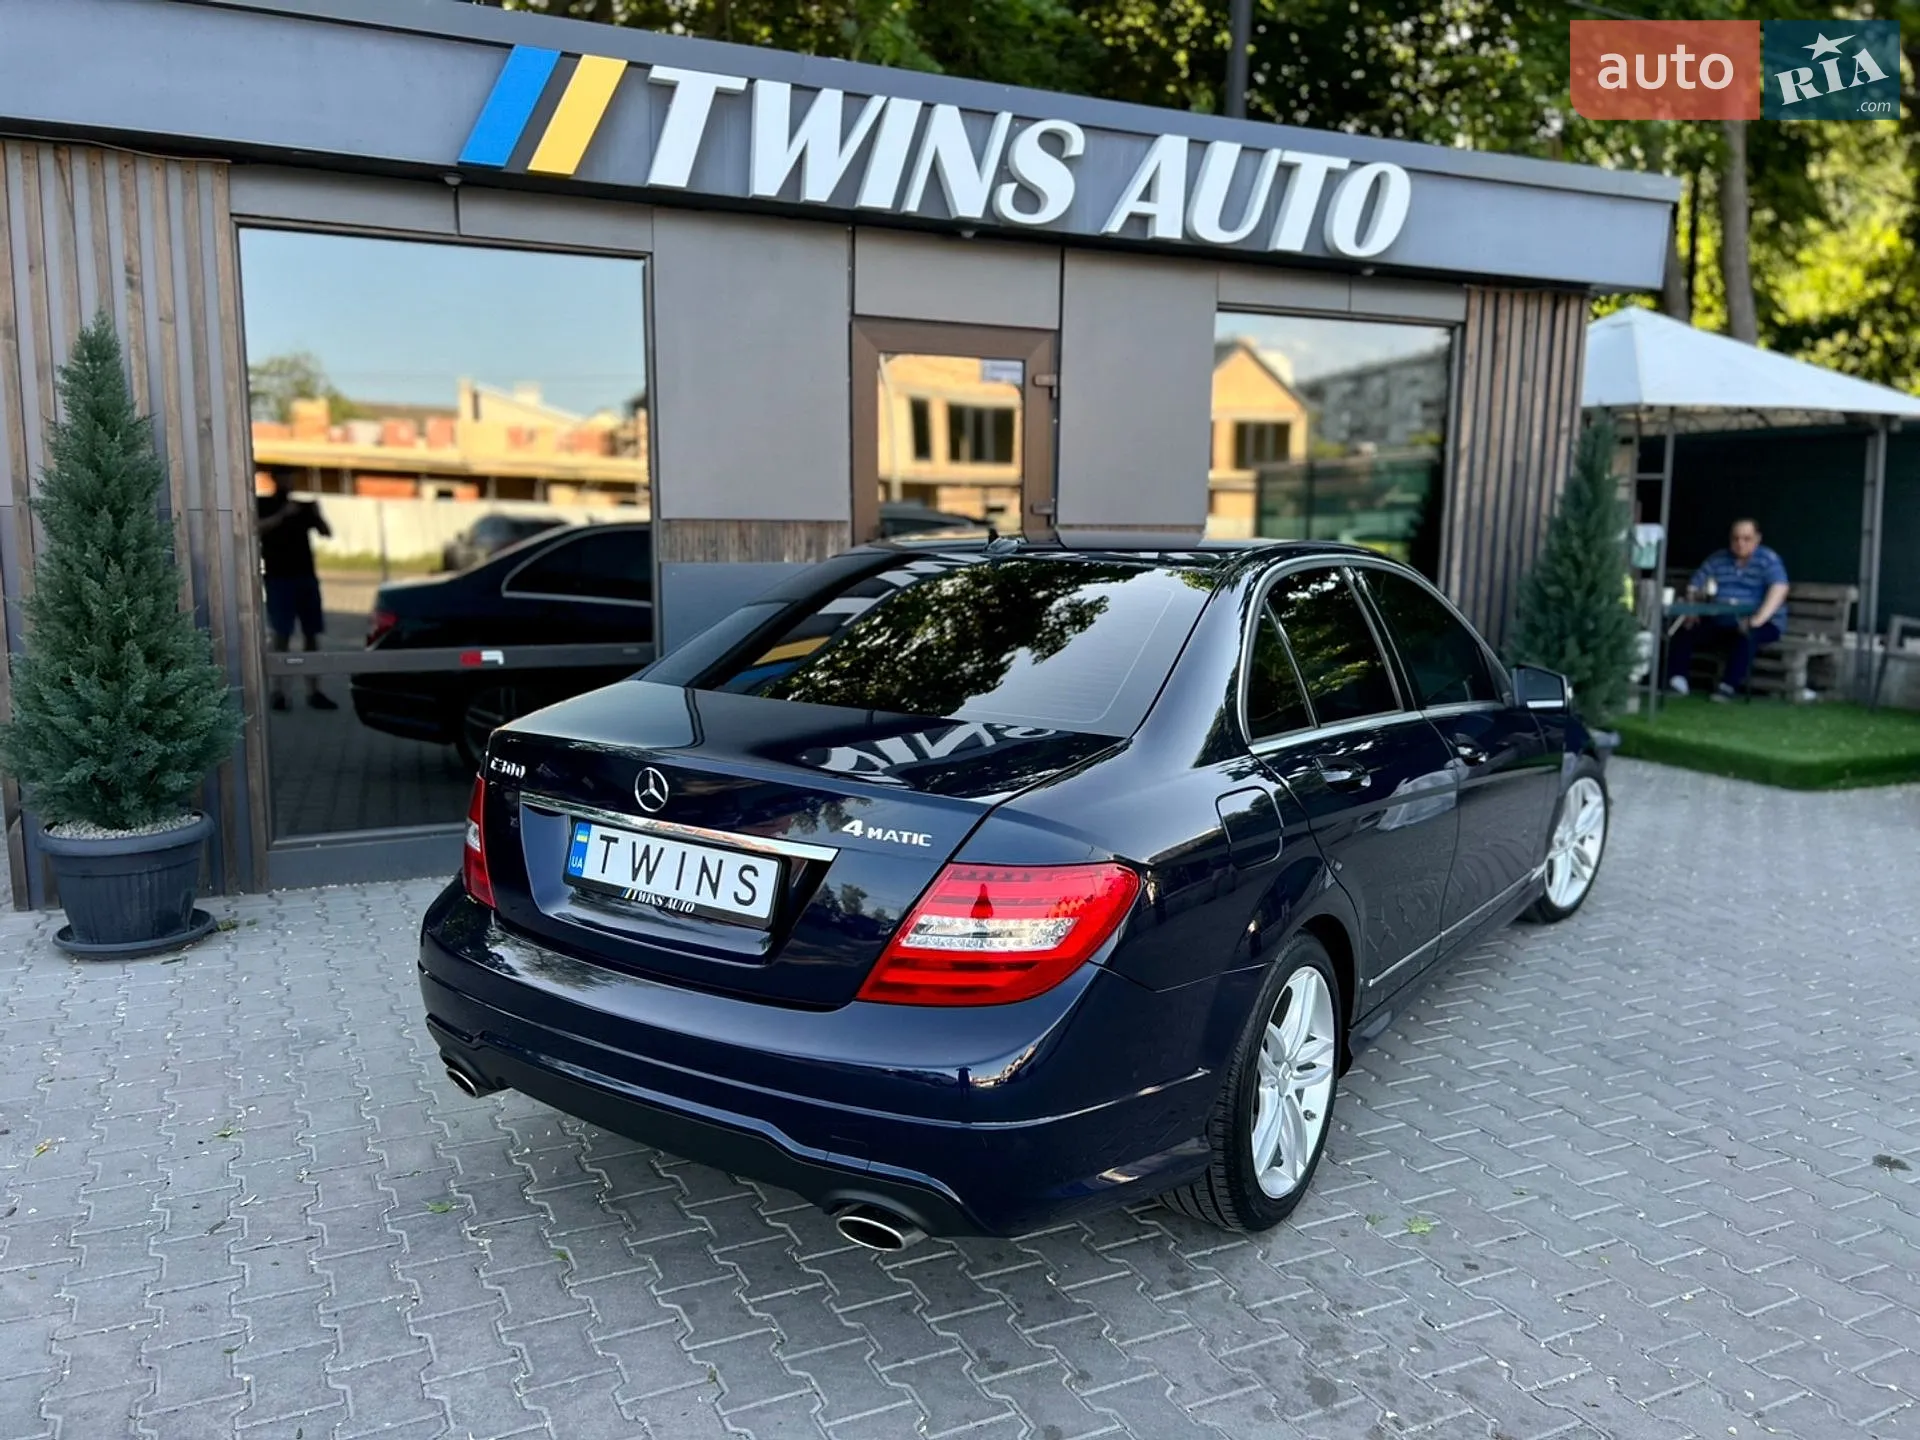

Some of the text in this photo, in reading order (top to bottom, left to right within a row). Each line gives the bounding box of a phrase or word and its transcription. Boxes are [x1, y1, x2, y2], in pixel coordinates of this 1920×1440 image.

[645, 64, 1412, 259] TWINS AUTO
[570, 855, 583, 869] UA
[599, 834, 759, 907] TWINS
[631, 888, 696, 914] TWINS AUTO
